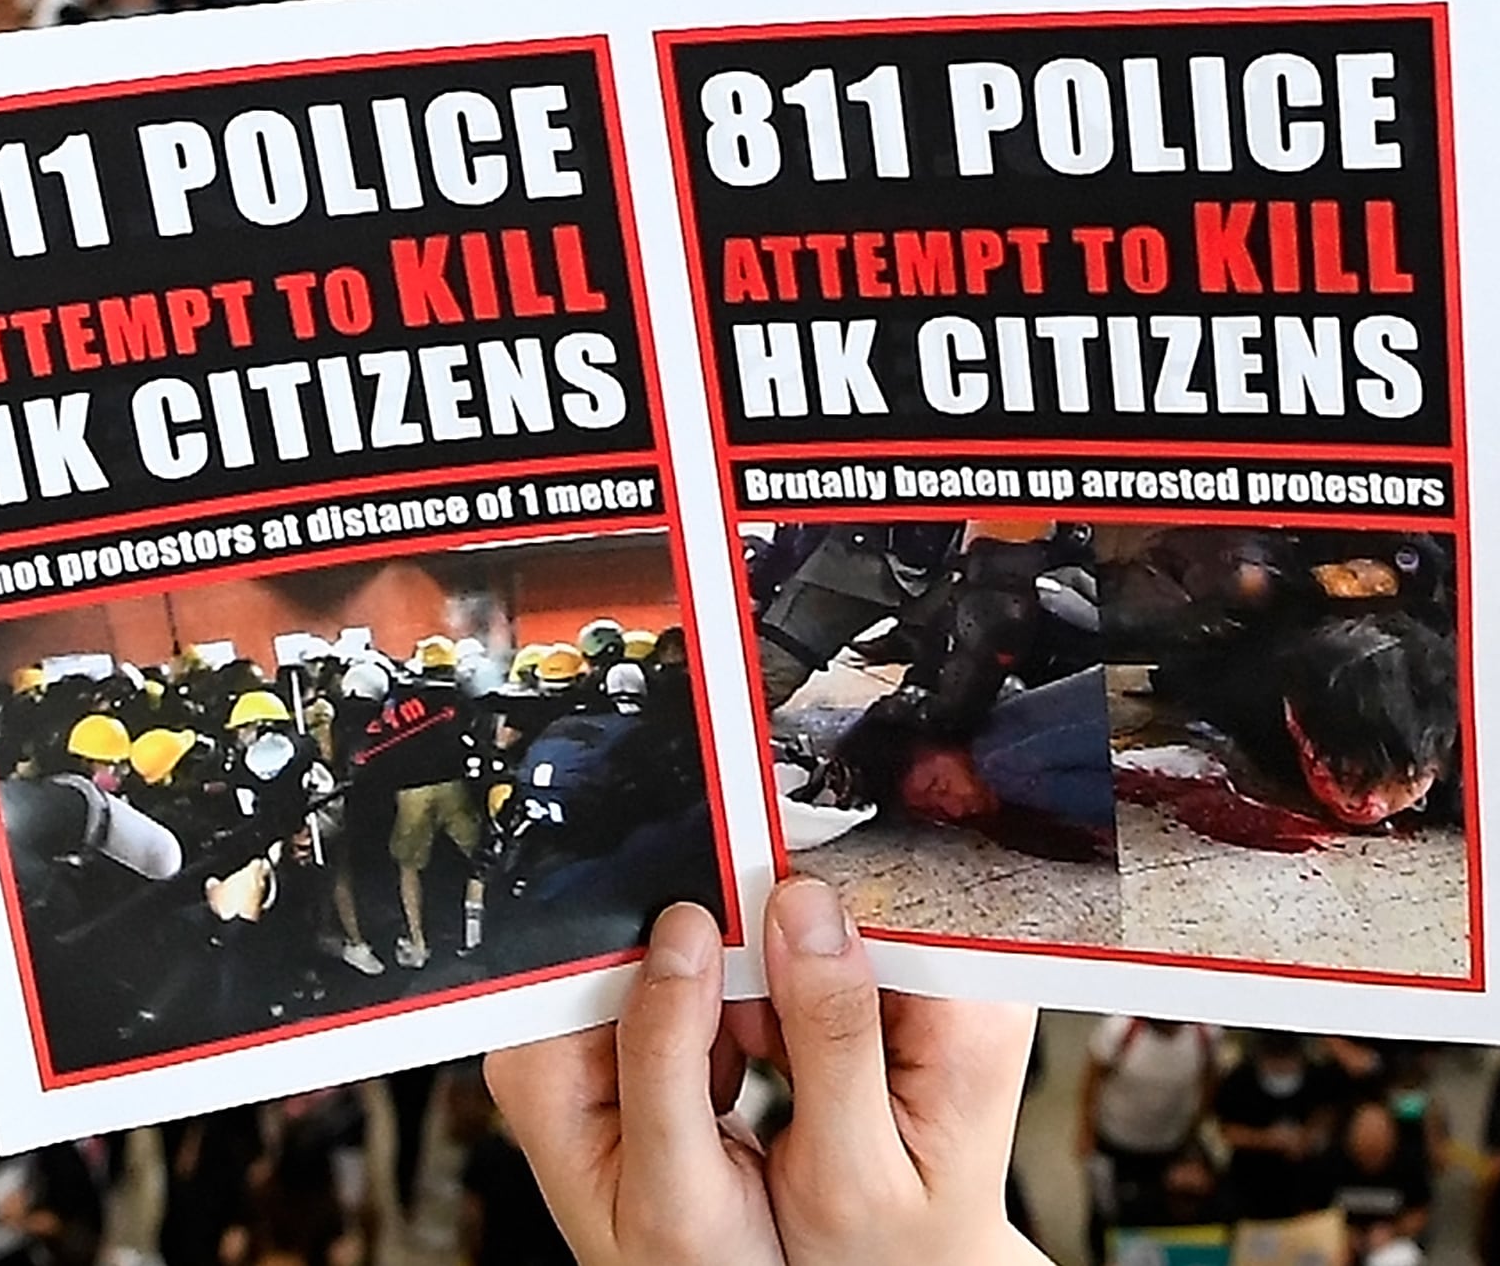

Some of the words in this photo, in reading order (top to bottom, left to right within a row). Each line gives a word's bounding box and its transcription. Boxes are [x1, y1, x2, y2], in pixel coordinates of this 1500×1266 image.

[138, 86, 582, 236] POLICE
[701, 66, 909, 186] 811
[948, 53, 1401, 175] POLICE
[275, 267, 372, 338] TO
[391, 225, 606, 326] KILL
[724, 231, 1049, 302] ATTEMPT
[1073, 227, 1168, 293] TO
[1195, 201, 1413, 293] KILL
[132, 328, 626, 479] CITIZENS
[733, 319, 889, 418] HK
[918, 315, 1422, 418] CITIZENS
[56, 524, 257, 587] protestors
[261, 514, 303, 550] at
[306, 495, 470, 543] distance
[475, 485, 514, 521] of
[518, 483, 540, 516] 1
[544, 478, 655, 515] meter
[744, 465, 887, 501] Brutally
[893, 465, 1021, 498] beaten
[1027, 469, 1075, 501] up
[1081, 467, 1240, 501] arrested
[1247, 472, 1445, 507] protestors
